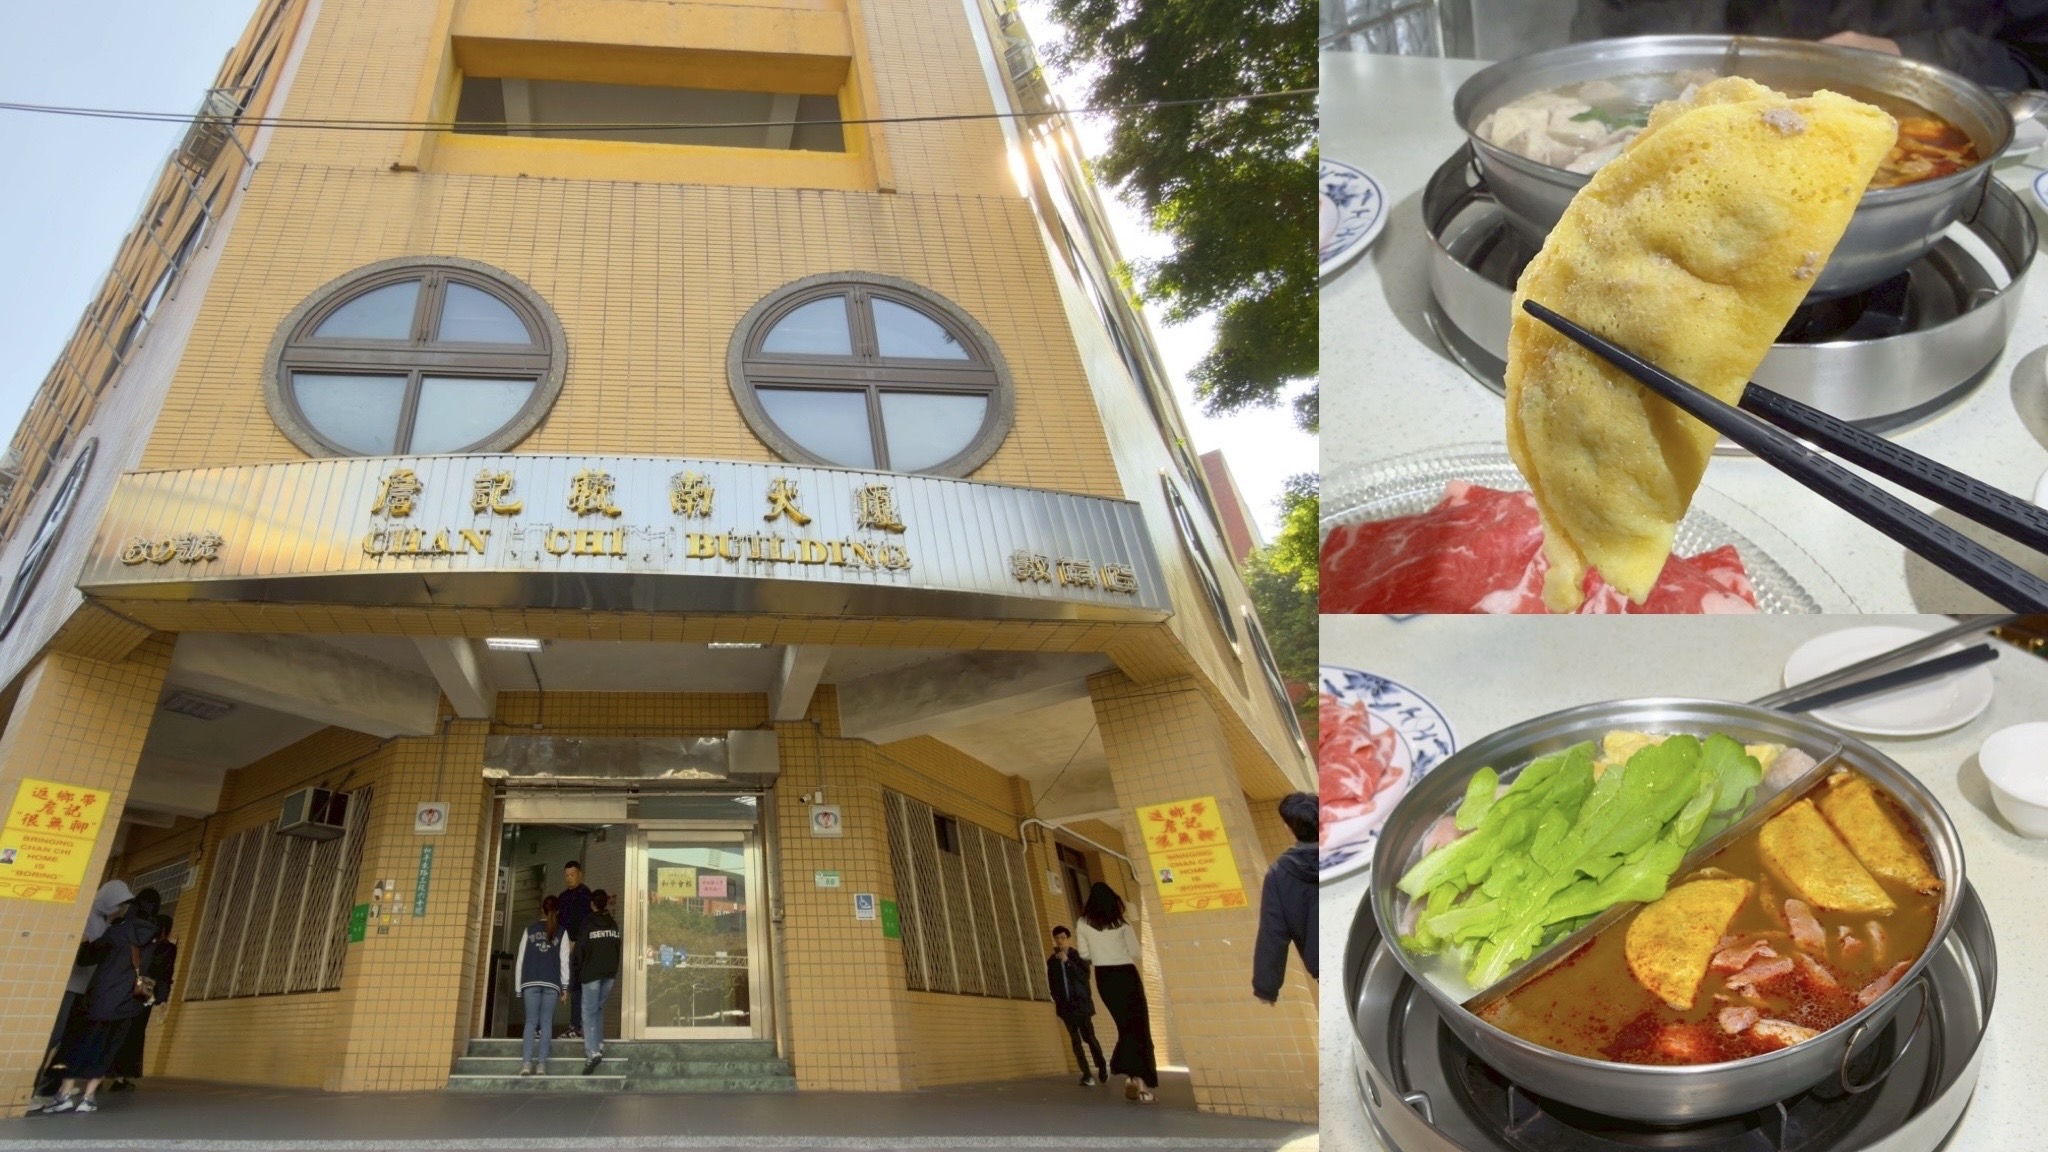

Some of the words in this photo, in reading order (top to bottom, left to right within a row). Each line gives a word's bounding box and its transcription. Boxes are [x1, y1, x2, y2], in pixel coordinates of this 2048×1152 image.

[362, 527, 491, 556] CHAN
[545, 528, 627, 557] CHI
[686, 531, 912, 570] BUILDING
[23, 836, 74, 848] BRINGING
[20, 844, 51, 853] CHAN
[27, 854, 58, 863] HOME
